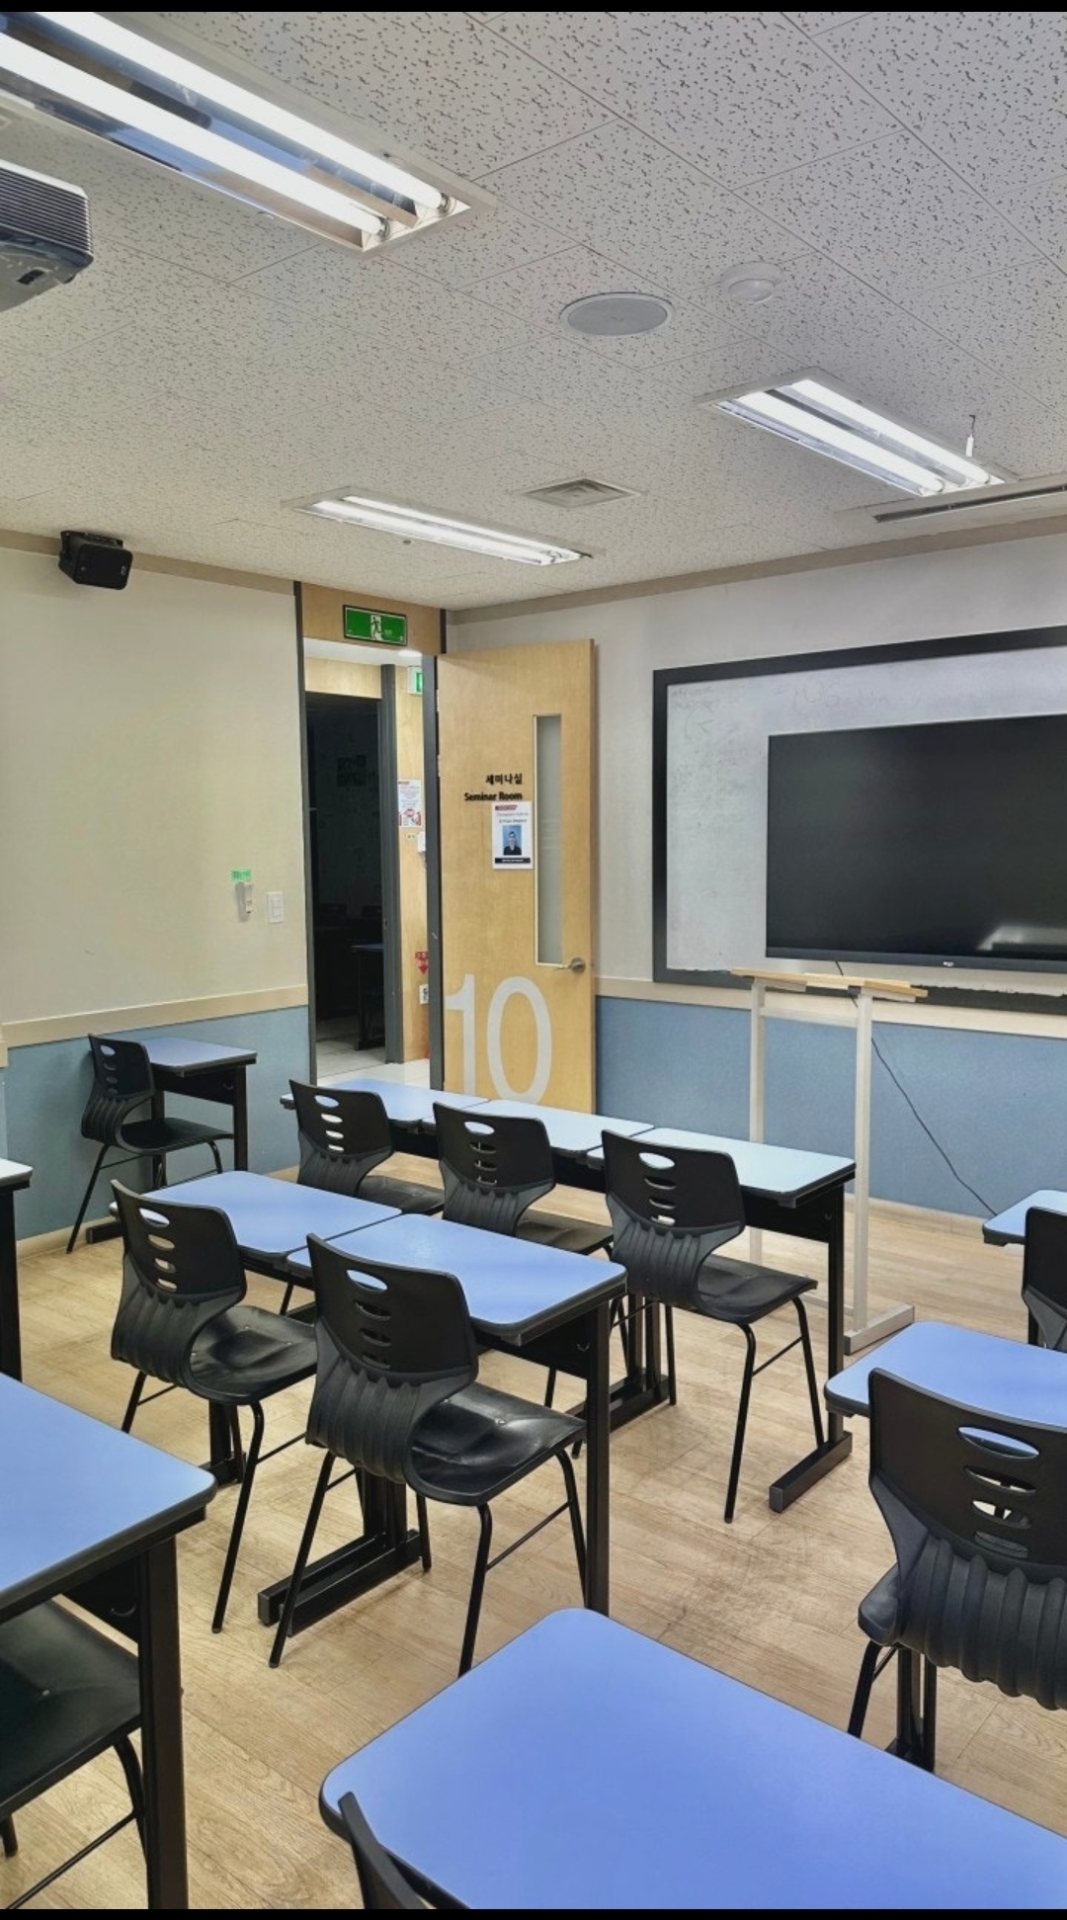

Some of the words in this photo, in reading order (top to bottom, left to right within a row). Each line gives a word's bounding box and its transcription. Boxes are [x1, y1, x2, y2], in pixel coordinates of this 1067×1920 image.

[486, 773, 523, 785] 세미나실
[464, 791, 497, 802] Seminar
[499, 791, 523, 801] Room
[444, 973, 552, 1104] 10
